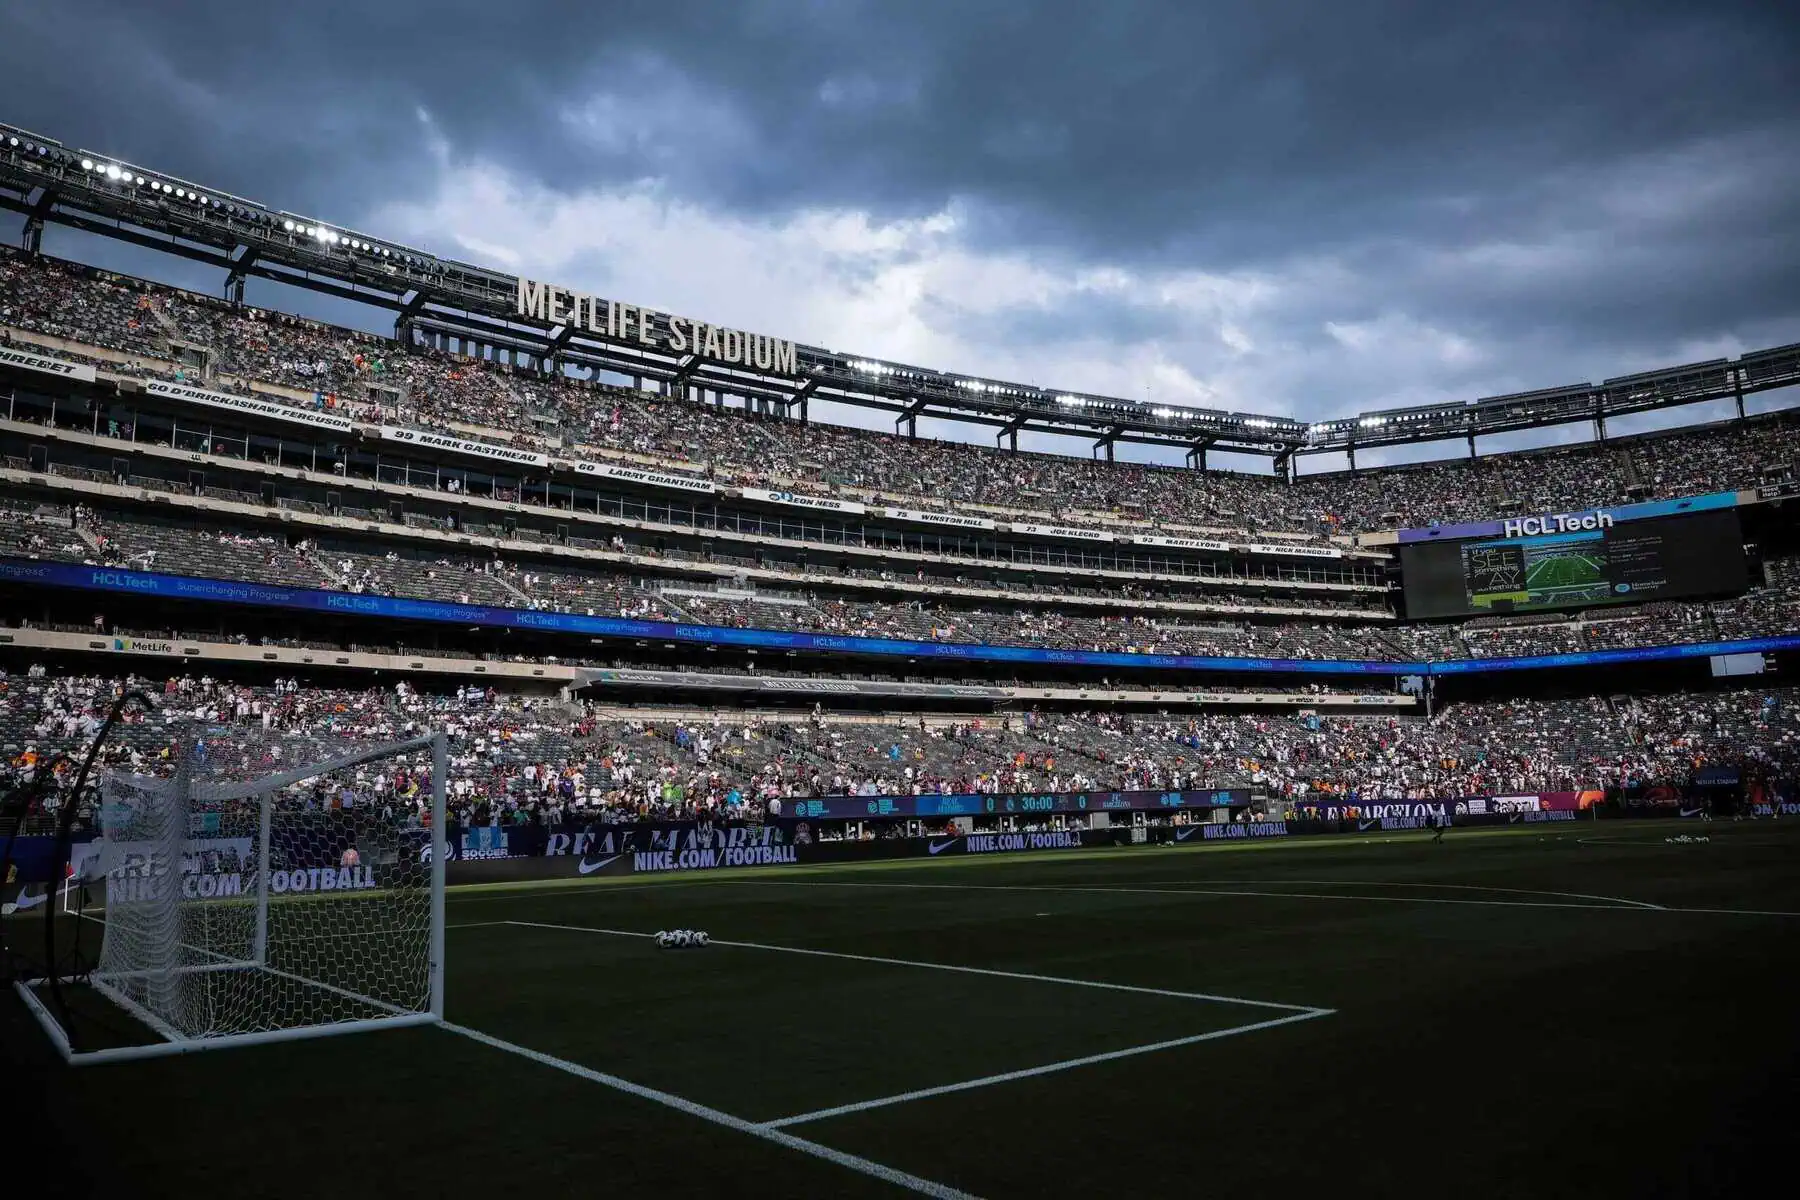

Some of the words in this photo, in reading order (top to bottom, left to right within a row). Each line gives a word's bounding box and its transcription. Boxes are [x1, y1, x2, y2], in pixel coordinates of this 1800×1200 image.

[517, 279, 656, 345] METLIFE
[668, 315, 797, 375] STADIUM
[171, 385, 279, 415] D'BRICKASHAW
[282, 409, 351, 429] FERGUSON
[394, 431, 414, 440] 99
[419, 435, 461, 449] MARK
[463, 443, 538, 462] GASTINEAU
[578, 463, 595, 472] 60
[608, 467, 645, 480] LARRY
[647, 474, 711, 490] GRANTHAM
[788, 497, 814, 506] EON
[815, 499, 840, 509] HESS
[920, 514, 962, 524] WINSTON
[963, 519, 983, 527] HILL
[1504, 511, 1613, 538] HCLTech
[1050, 528, 1066, 536] JOE
[1472, 552, 1516, 568] SEE
[92, 572, 159, 589] HCLTech
[176, 580, 249, 598] Supercharging
[327, 595, 380, 611] HCLTech
[516, 613, 560, 627] HCLTech
[675, 627, 713, 639] HCLTech
[132, 640, 173, 653] MetLife
[813, 637, 847, 648] HCLTech
[936, 645, 968, 656] HCLTech
[1022, 796, 1053, 810] 30:00
[1079, 795, 1087, 809] 0
[1203, 822, 1288, 840] NIKE.COM/FOOTBALL
[967, 831, 1082, 852] NIKE.COM/FOOTBA
[634, 845, 797, 872] NIKE.COM/FOOTBALL
